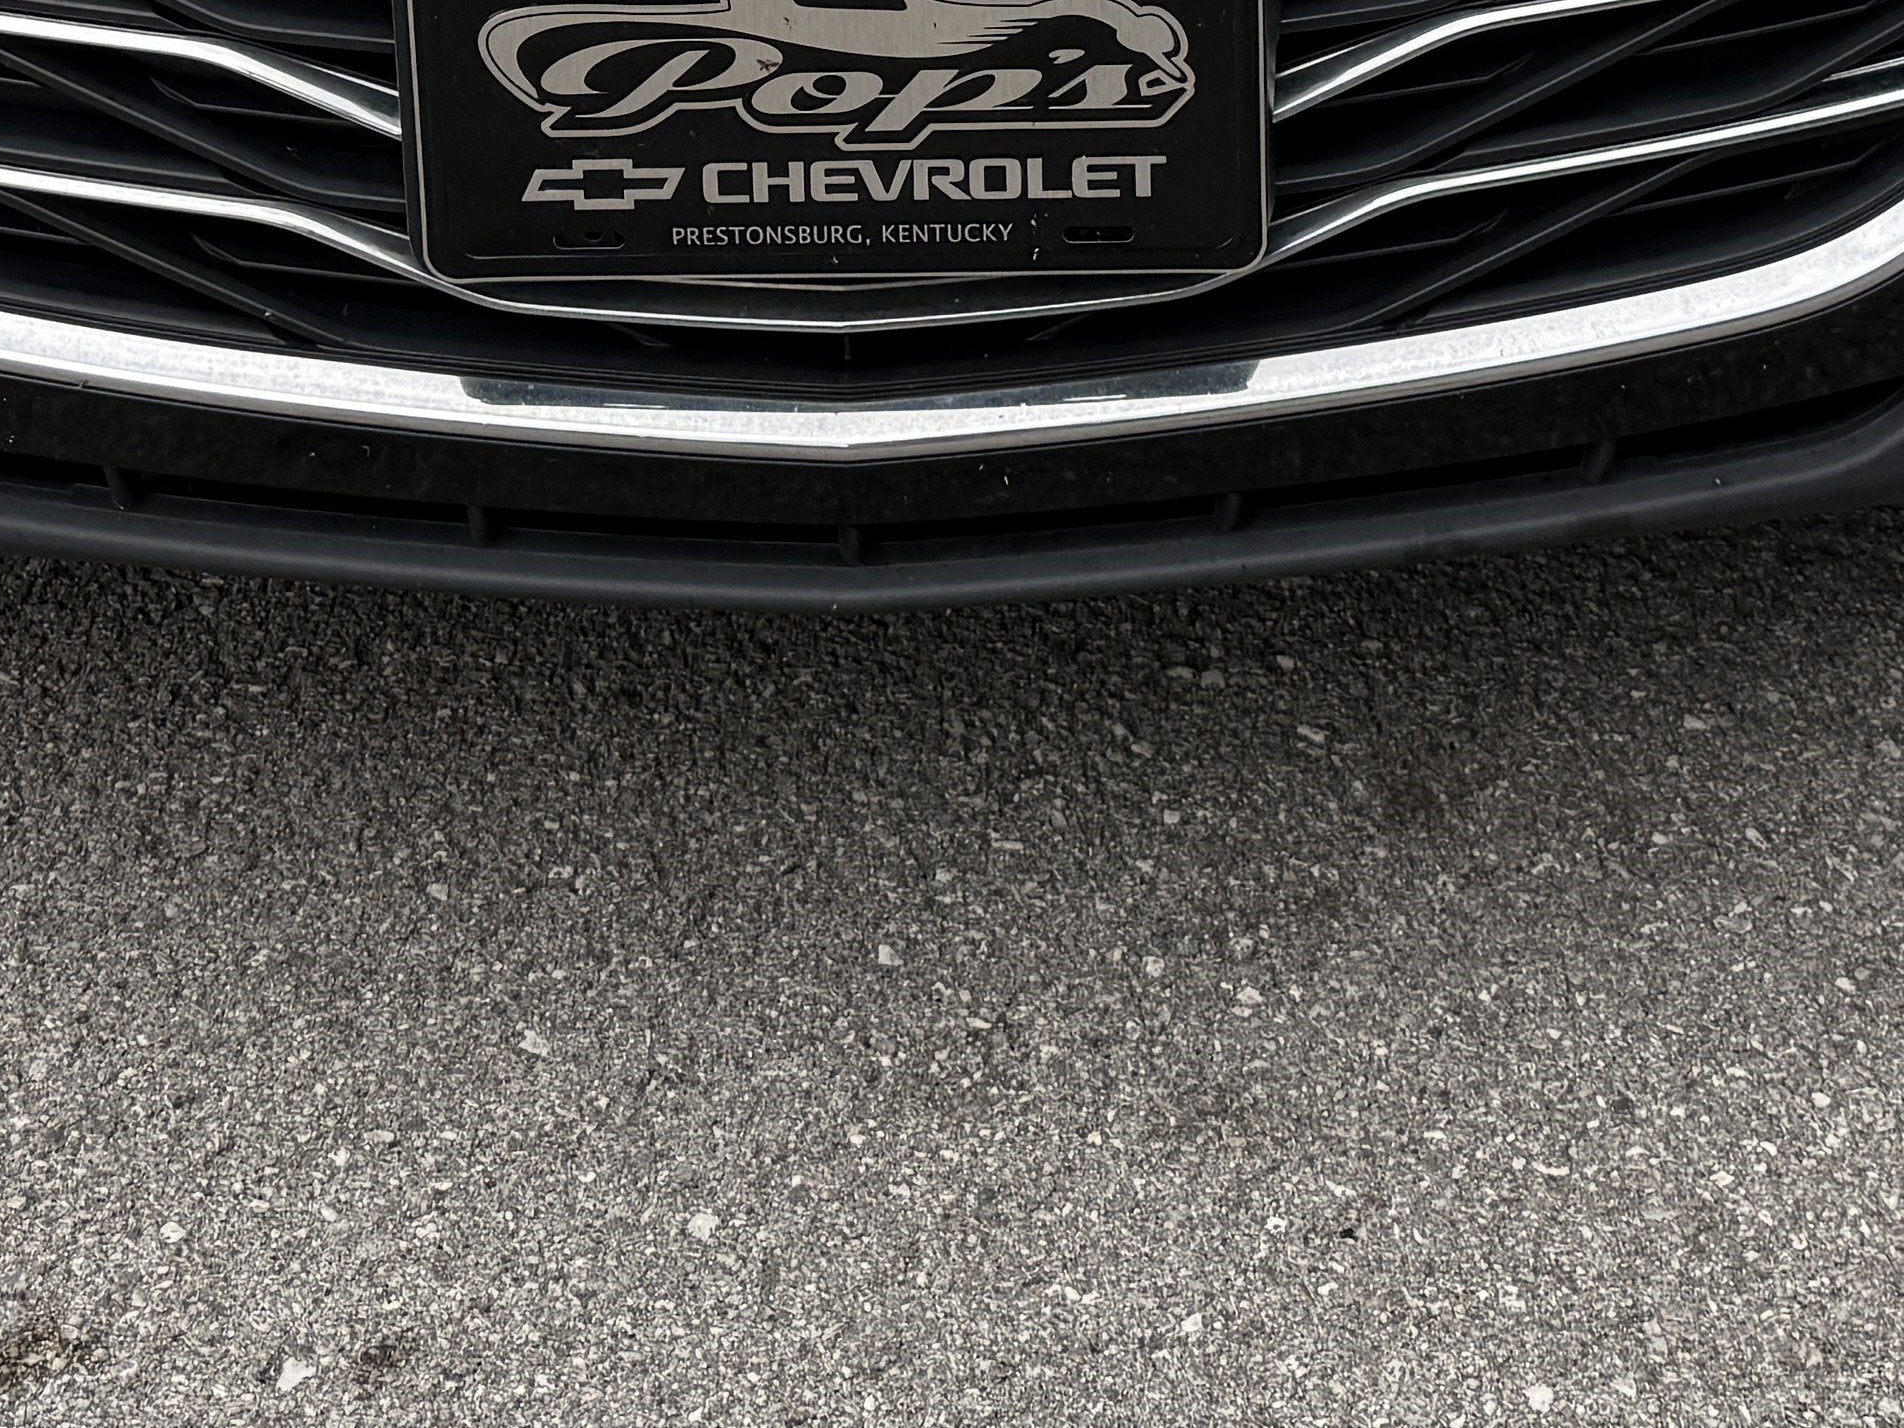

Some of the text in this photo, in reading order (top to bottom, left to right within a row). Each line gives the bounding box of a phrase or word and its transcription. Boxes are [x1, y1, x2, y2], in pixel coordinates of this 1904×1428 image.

[540, 37, 1153, 132] Pop's
[702, 155, 1167, 203] CHEVROLET
[672, 221, 1013, 248] PRESTONSBURG, KENTUCKY
